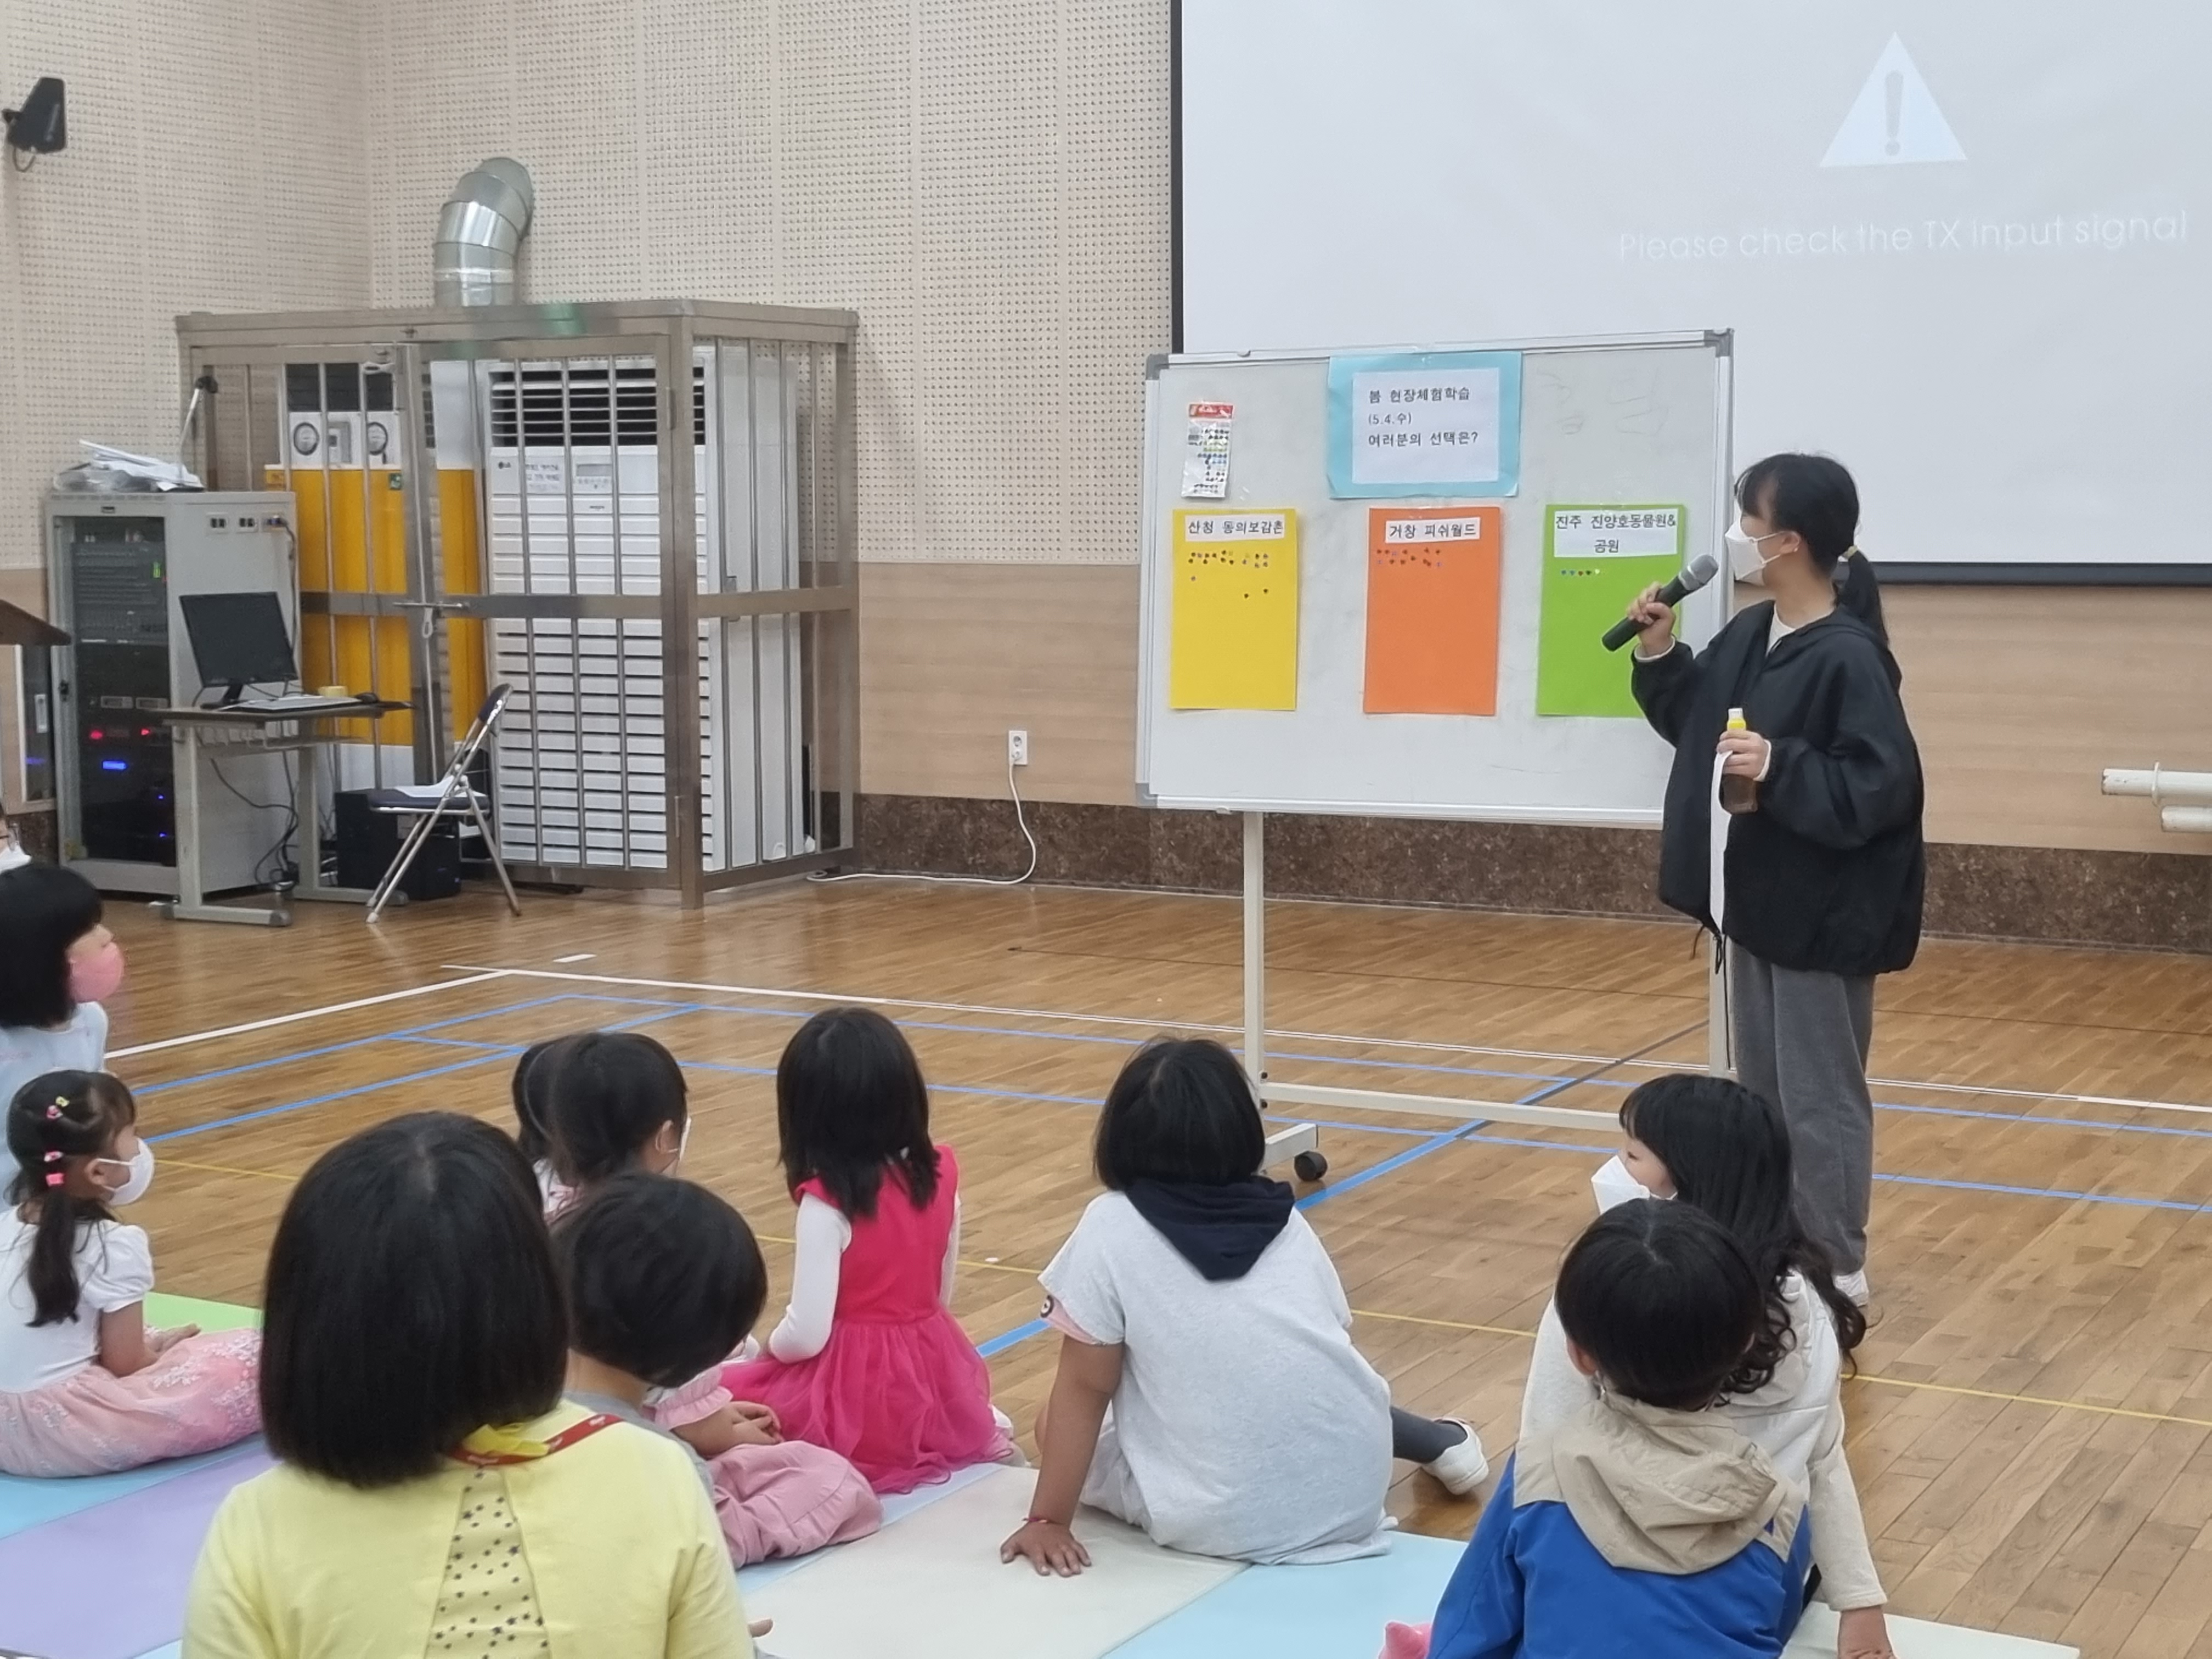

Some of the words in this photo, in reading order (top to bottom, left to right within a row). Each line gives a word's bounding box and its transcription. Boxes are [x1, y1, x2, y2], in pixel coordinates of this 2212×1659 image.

[1619, 232, 1729, 262] Please
[1739, 224, 1848, 258] check
[1855, 222, 1912, 252] the
[1923, 219, 1961, 251] TX
[2074, 208, 2186, 251] signal
[1369, 390, 1381, 403] 봄
[1390, 387, 1470, 403] 현장체험학습
[1368, 412, 1412, 425] (5.4.수)
[1368, 432, 1421, 448] 여러분의
[1430, 431, 1479, 446] 선택은?
[1188, 520, 1214, 534] 산청
[1222, 520, 1284, 534] 동의보감촌
[1556, 515, 1582, 529] 진주
[1590, 514, 1676, 529] 진양호동물원&
[1390, 524, 1416, 539] 거창
[1424, 523, 1476, 538] 피쉬월드
[1594, 539, 1619, 553] 공원
